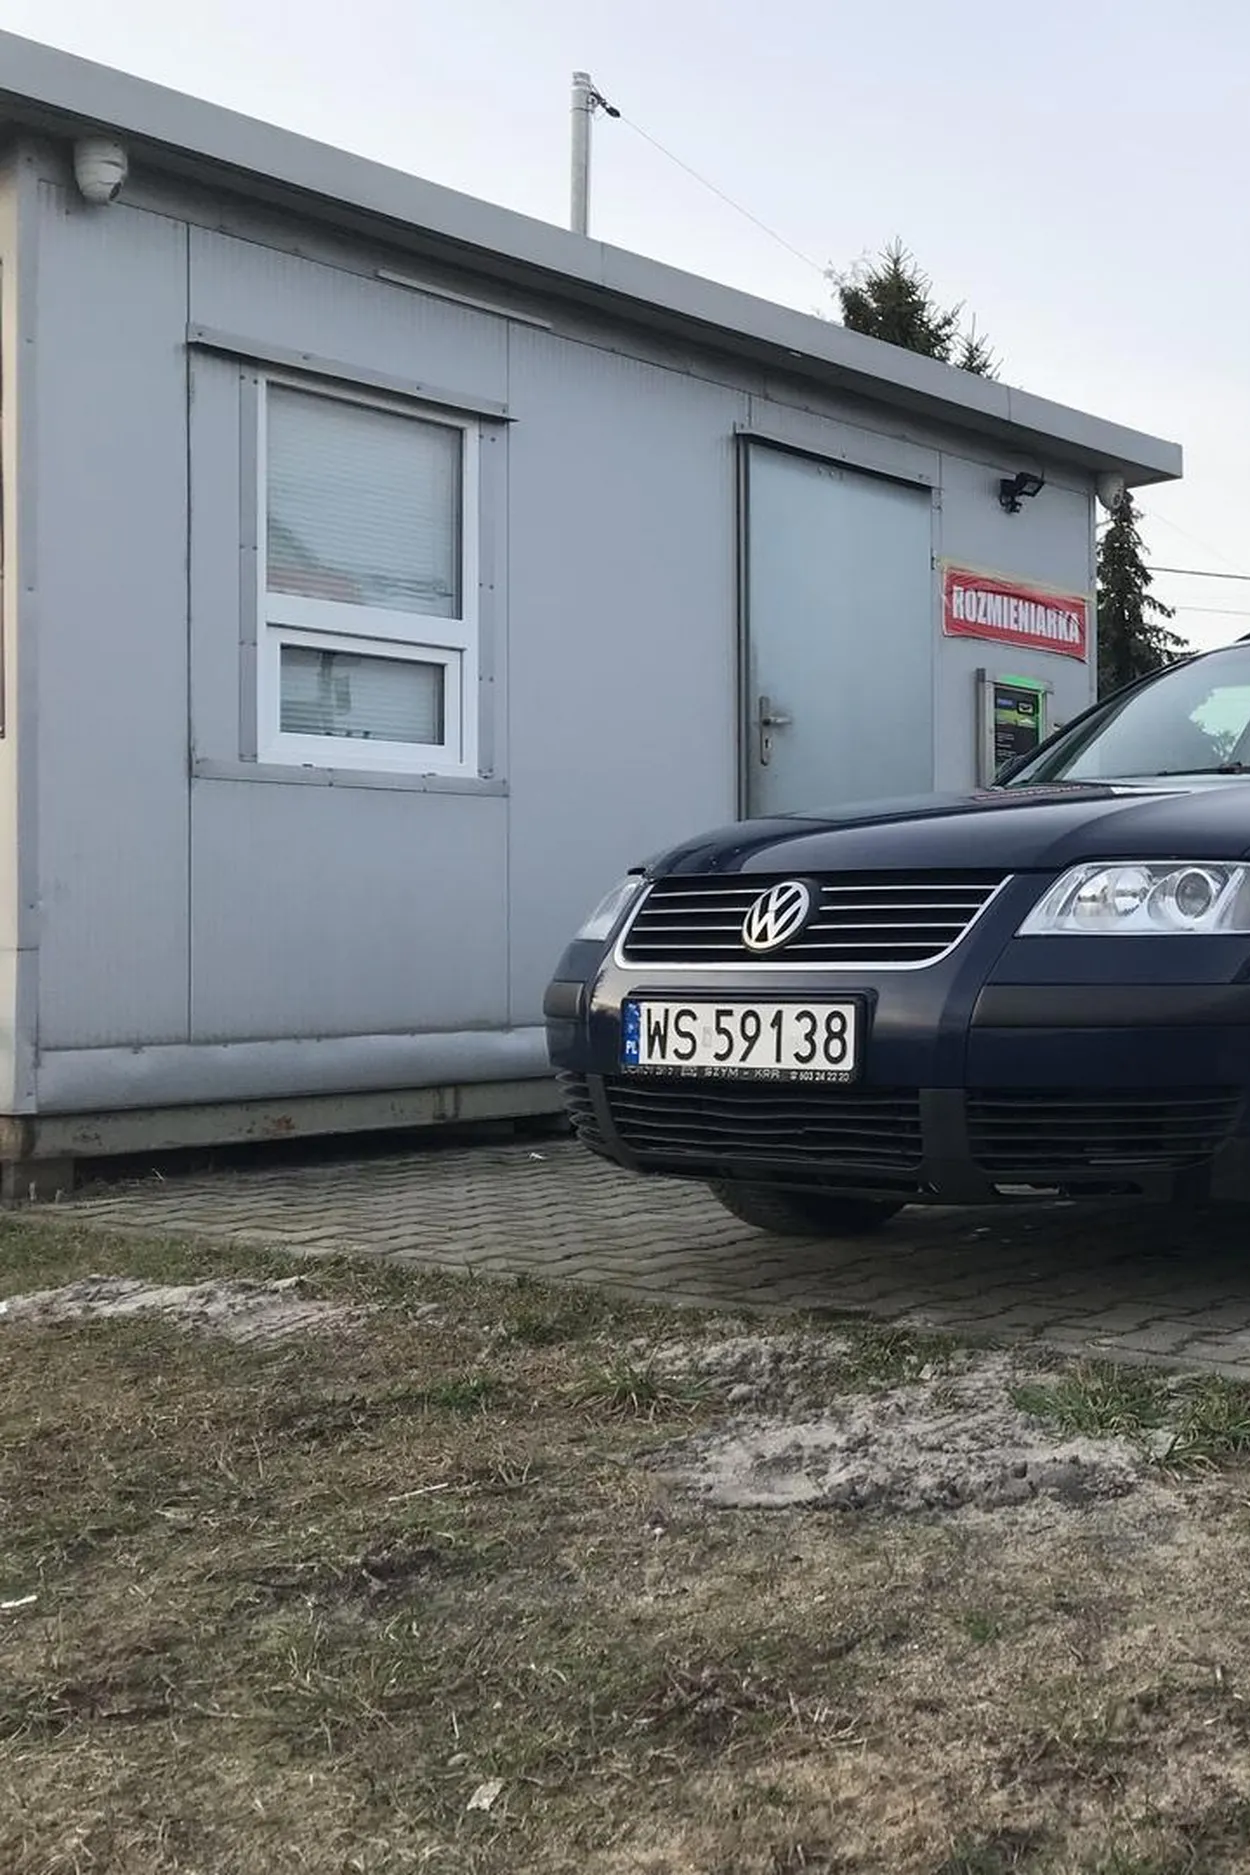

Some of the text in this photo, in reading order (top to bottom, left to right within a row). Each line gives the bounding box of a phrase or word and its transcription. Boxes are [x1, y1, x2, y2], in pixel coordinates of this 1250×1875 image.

[952, 585, 1080, 644] ROZMIENIARKA
[625, 1040, 637, 1055] PL
[646, 1008, 848, 1065] WS 59138
